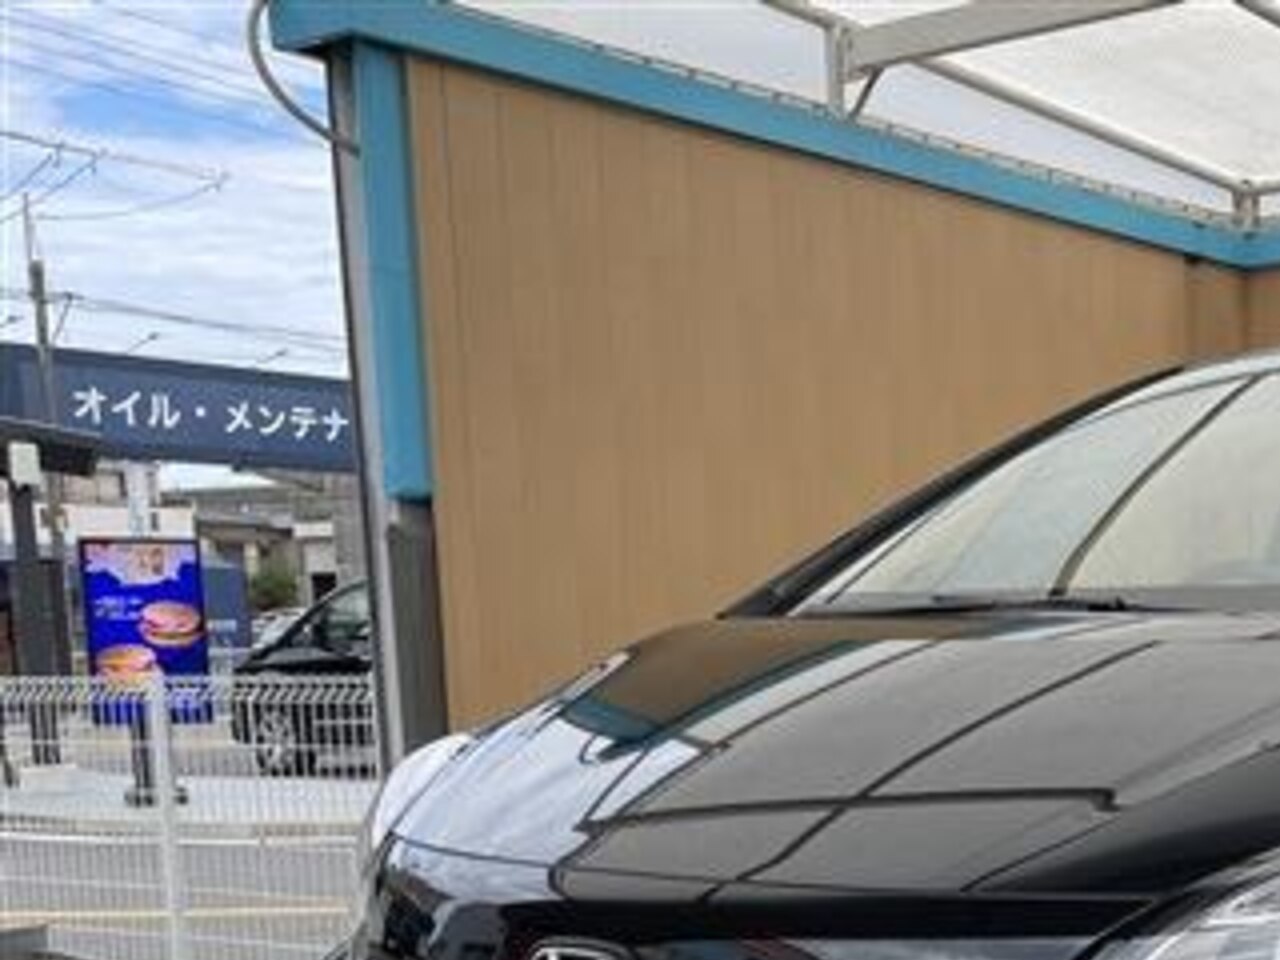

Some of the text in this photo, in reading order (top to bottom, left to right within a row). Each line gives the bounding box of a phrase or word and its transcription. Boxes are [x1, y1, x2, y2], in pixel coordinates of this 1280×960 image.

[73, 386, 348, 441] オイル・メンテナ
